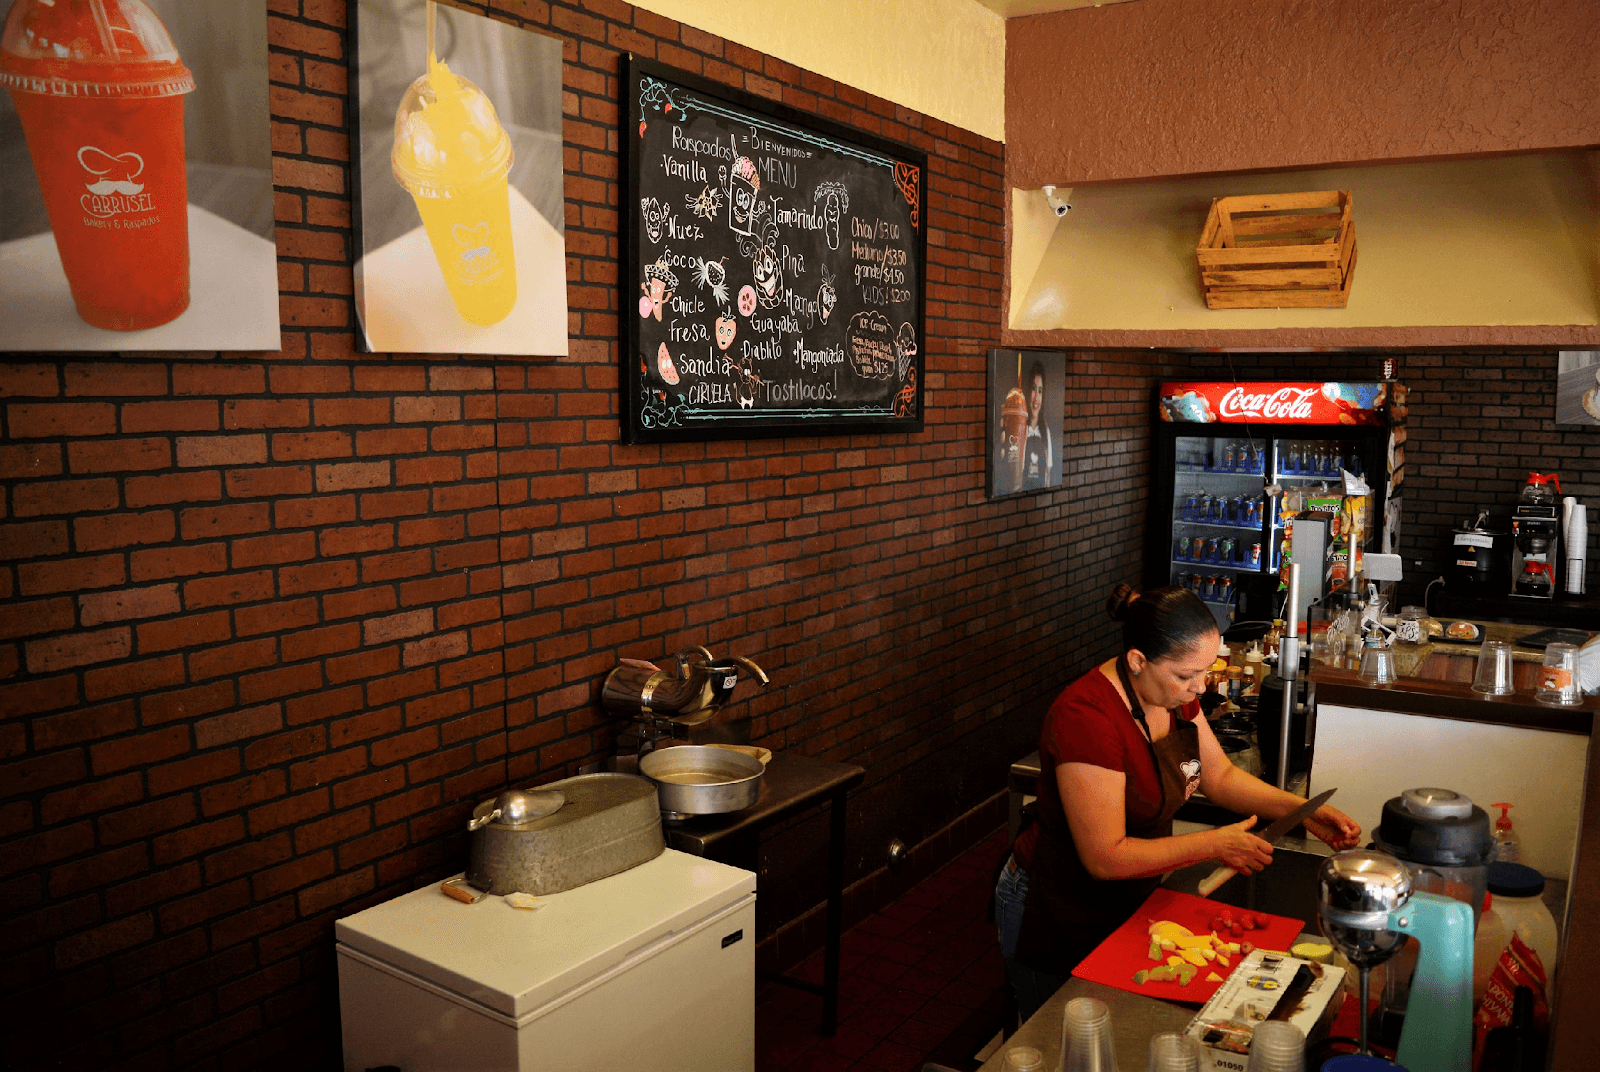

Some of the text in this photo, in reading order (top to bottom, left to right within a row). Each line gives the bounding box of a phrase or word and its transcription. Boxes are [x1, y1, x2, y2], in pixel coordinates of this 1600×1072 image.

[672, 125, 732, 161] Raspados
[663, 154, 708, 183] Vanilla
[758, 156, 797, 189] MENU
[80, 193, 156, 218] CARRUSEL
[769, 195, 824, 231] Tamarindo
[83, 216, 112, 230] Bakery
[123, 215, 160, 229] Raspados
[668, 214, 704, 241] Nuez
[664, 248, 697, 269] Coco
[671, 294, 706, 318] Chicle
[785, 288, 818, 330] Mango
[670, 318, 711, 342] Fresa
[750, 313, 802, 343] Guayaba
[743, 336, 782, 360] Diablito
[1219, 387, 1320, 418] Coca-Cola
[1217, 1059, 1244, 1072] 01050
